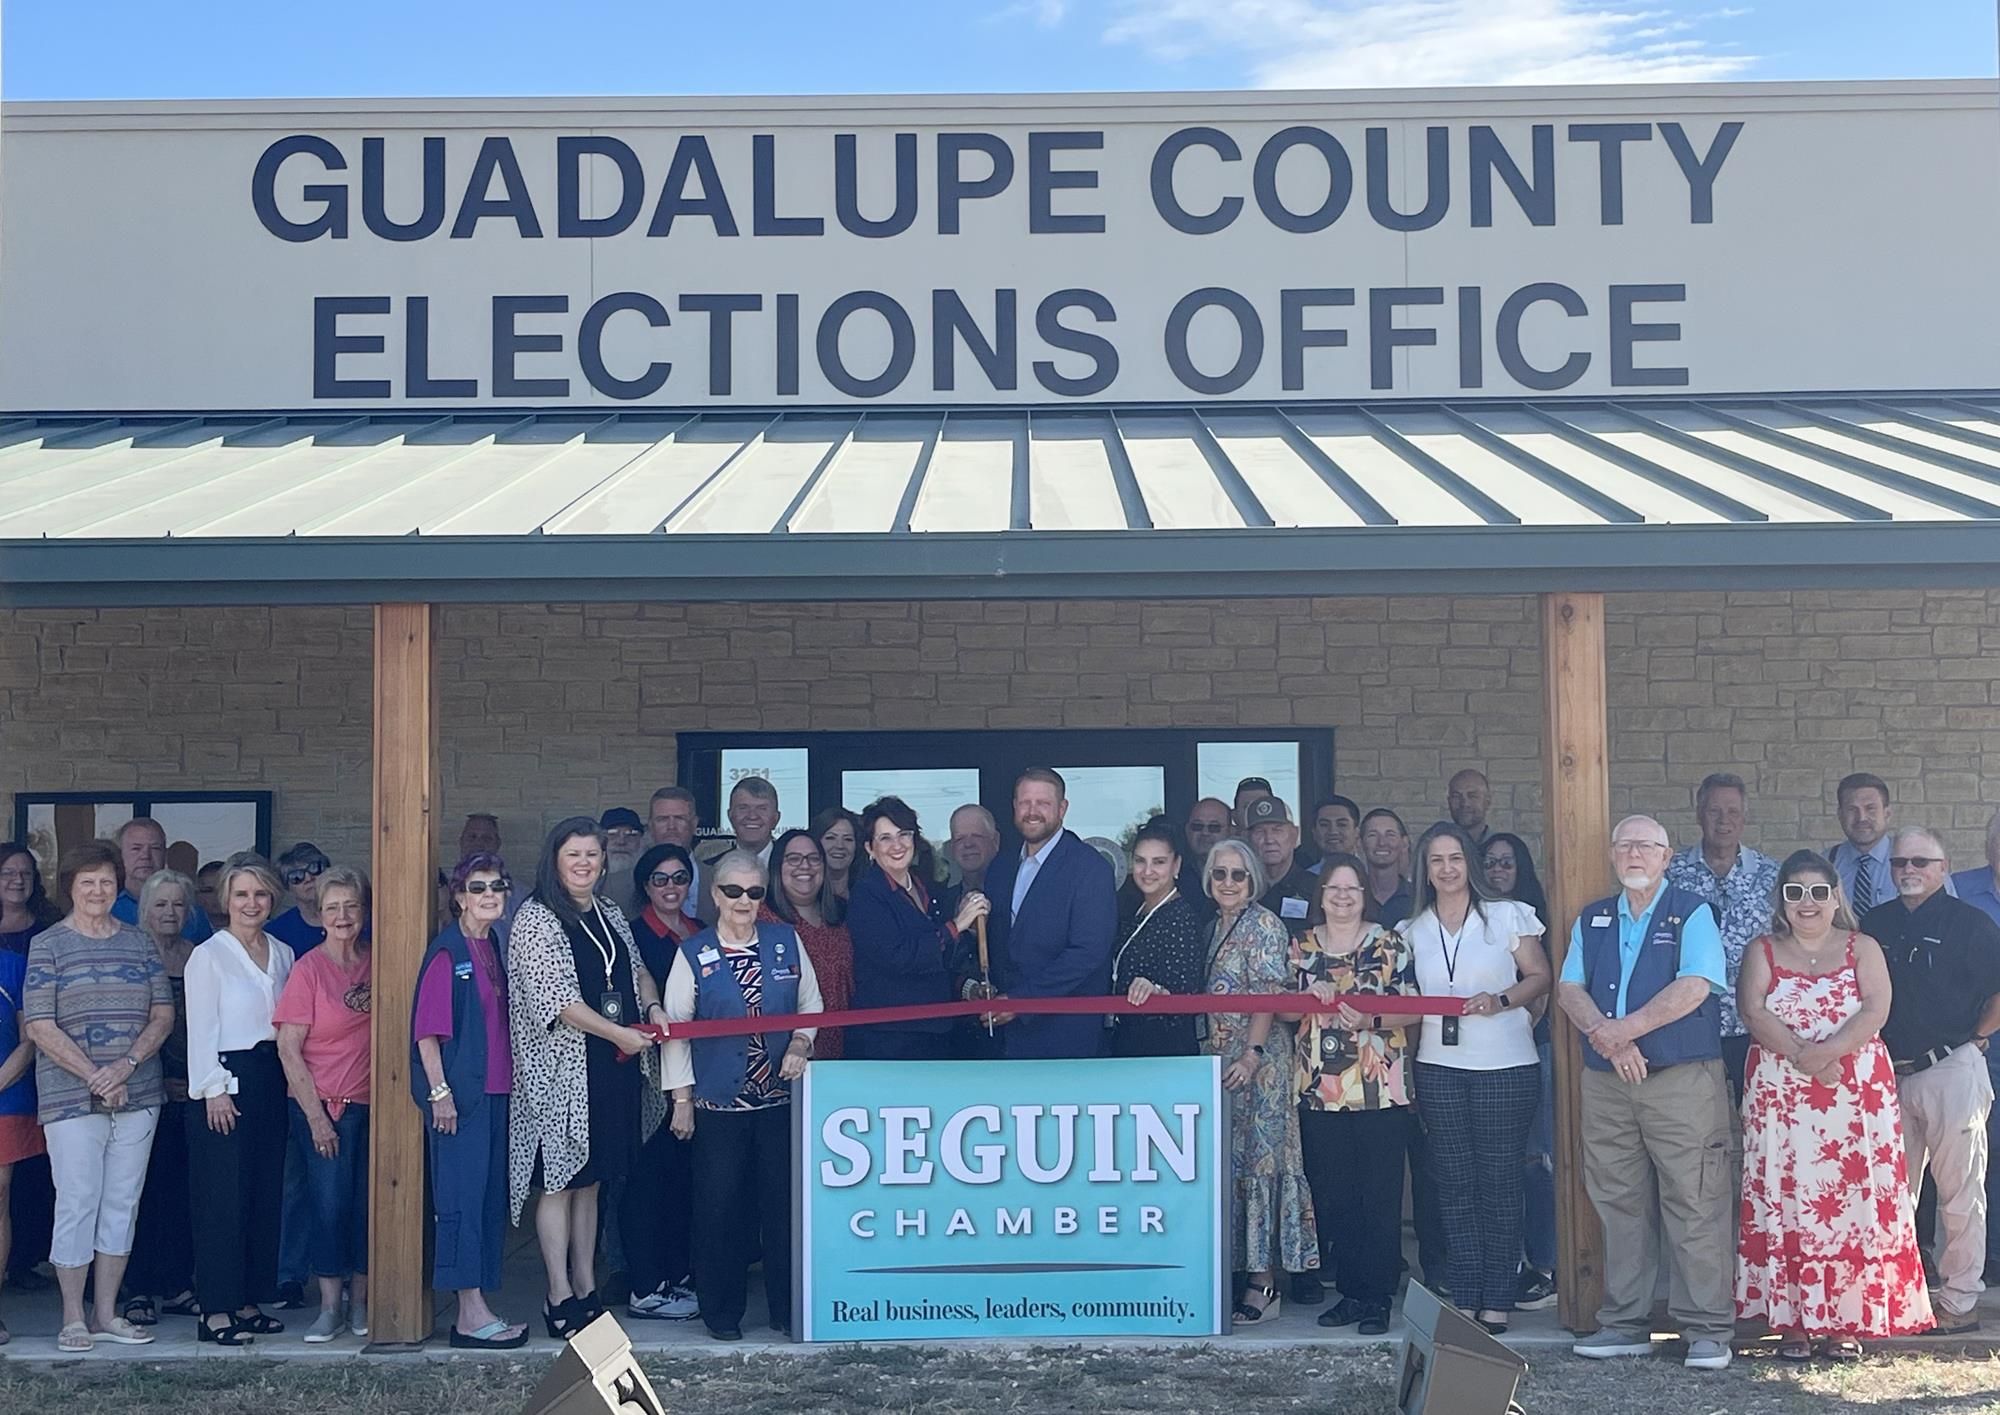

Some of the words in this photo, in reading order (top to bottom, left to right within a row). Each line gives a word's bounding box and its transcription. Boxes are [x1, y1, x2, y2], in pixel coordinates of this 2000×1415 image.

[252, 133, 1106, 243] GUADALUPE
[1150, 122, 1745, 235] COUNTY
[313, 288, 1120, 400] ELECTIONS
[1164, 282, 1689, 395] OFFICE
[820, 1104, 1201, 1187] SEGUIN
[849, 1206, 1165, 1238] CHAMBER
[831, 1299, 879, 1323] Real
[885, 1298, 980, 1324] business,
[985, 1297, 1067, 1323] leaders,
[1071, 1296, 1196, 1324] community.
